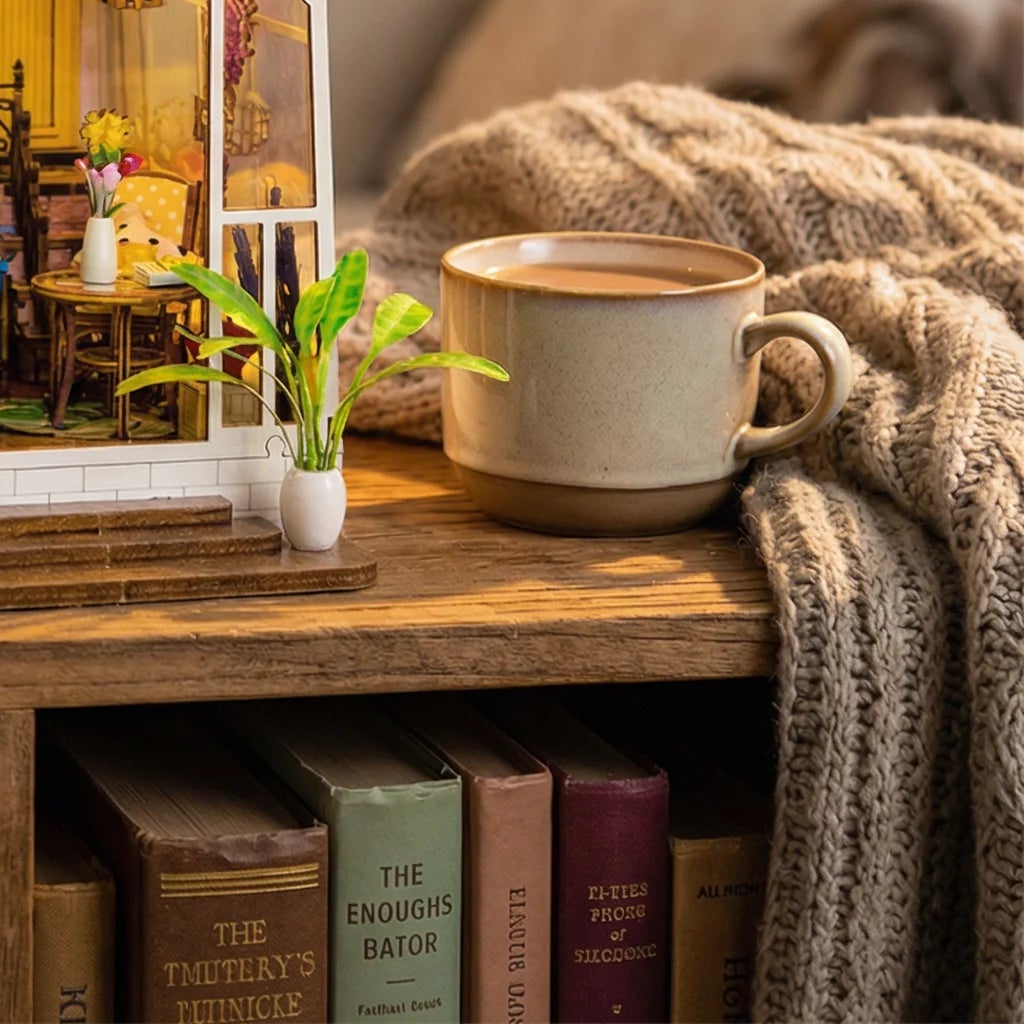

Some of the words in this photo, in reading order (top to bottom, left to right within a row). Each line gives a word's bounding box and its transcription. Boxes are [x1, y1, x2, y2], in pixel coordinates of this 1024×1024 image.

[380, 863, 423, 888] THE
[346, 893, 453, 925] ENOUGHS
[212, 919, 267, 948] THE
[363, 931, 438, 961] BATOR
